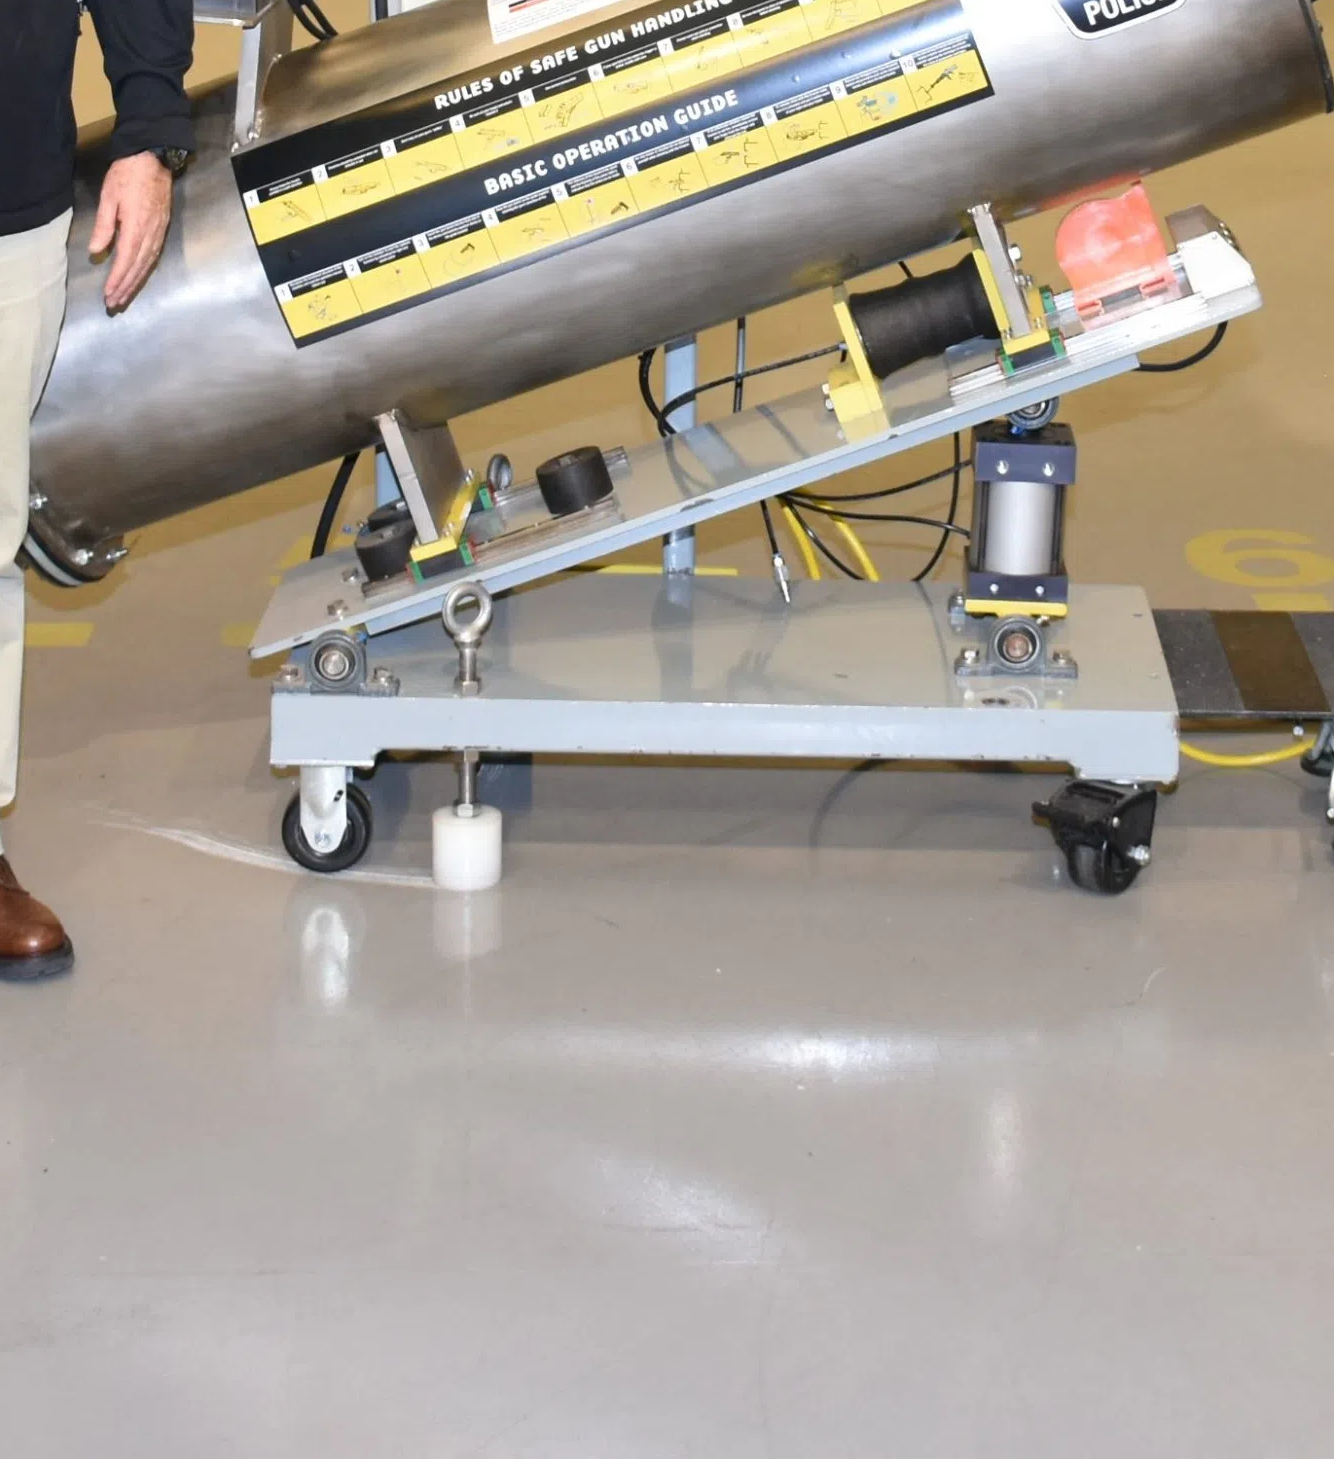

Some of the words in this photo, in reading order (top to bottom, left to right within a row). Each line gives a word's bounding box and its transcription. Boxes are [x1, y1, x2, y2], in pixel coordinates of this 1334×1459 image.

[434, 78, 493, 110] RULES
[500, 65, 524, 85] OF
[531, 45, 578, 74] SAFE
[585, 26, 625, 54] GUN
[484, 160, 547, 195] BASIC
[552, 115, 668, 170] OPERATION
[674, 90, 739, 125] GUIDE
